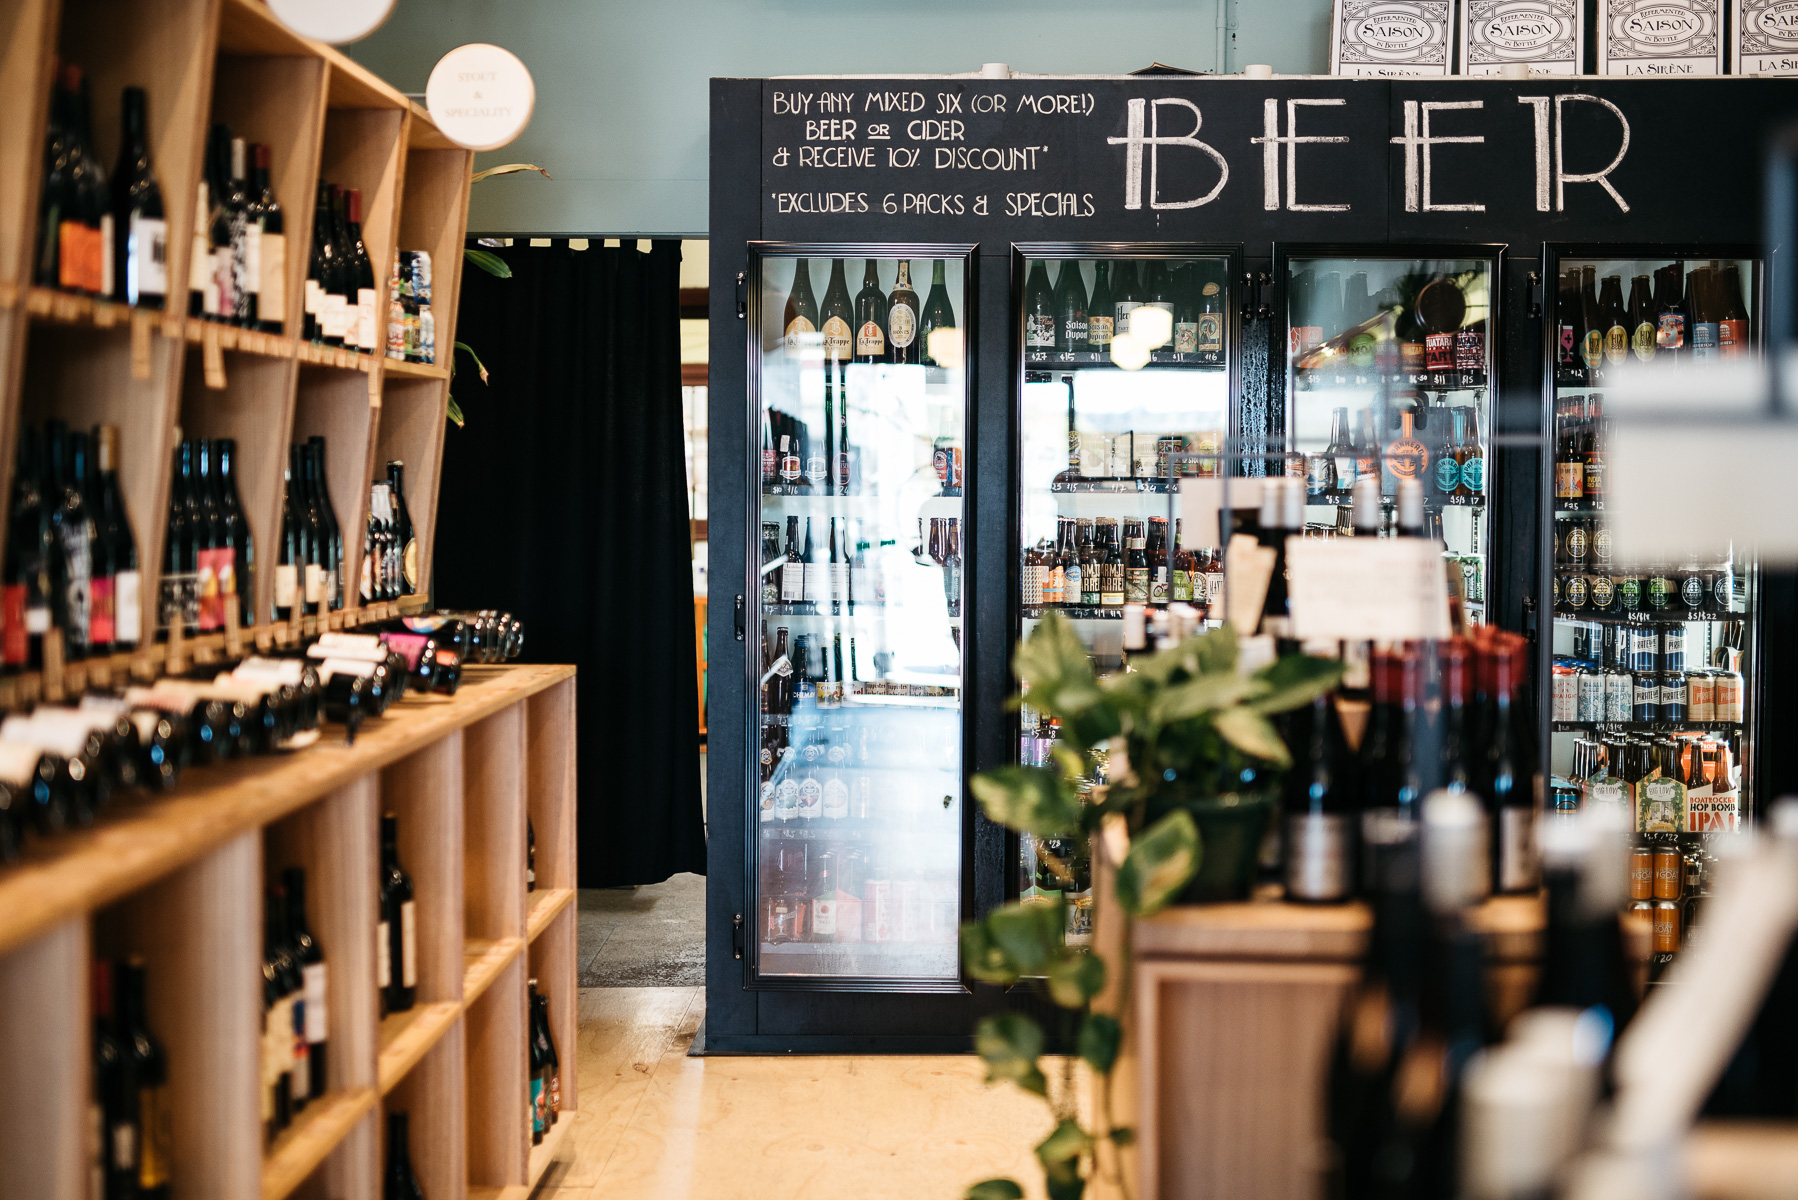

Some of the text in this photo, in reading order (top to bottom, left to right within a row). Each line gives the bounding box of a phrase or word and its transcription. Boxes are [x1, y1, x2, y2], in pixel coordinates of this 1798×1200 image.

[1362, 23, 1424, 38] SAISON
[1490, 23, 1553, 37] SAISON
[1630, 18, 1694, 33] SAISON
[1626, 65, 1644, 76] LA
[1759, 60, 1777, 71] LA
[458, 72, 497, 82] STOUT
[472, 91, 483, 99] &
[773, 91, 1095, 116] BUY ANY MIXED SIX (OR MORE!)
[445, 107, 512, 118] SPECIALITY
[806, 120, 964, 141] BEER OR CIDER
[772, 148, 790, 167] &
[799, 146, 876, 168] RECEIVE
[886, 147, 920, 168] 10%
[1107, 94, 1630, 213] BEER
[882, 193, 898, 214] 6
[903, 193, 964, 215] PACKS
[973, 196, 989, 216] &
[1005, 192, 1095, 217] SPECIALS
[1611, 333, 1623, 344] HIX
[1640, 330, 1652, 340] HIX
[1174, 588, 1186, 599] IPA
[1606, 786, 1618, 795] LOVE
[1649, 786, 1672, 795] BIG LOVE
[1690, 803, 1735, 811] HOP BOMB
[1690, 812, 1725, 832] IPA
